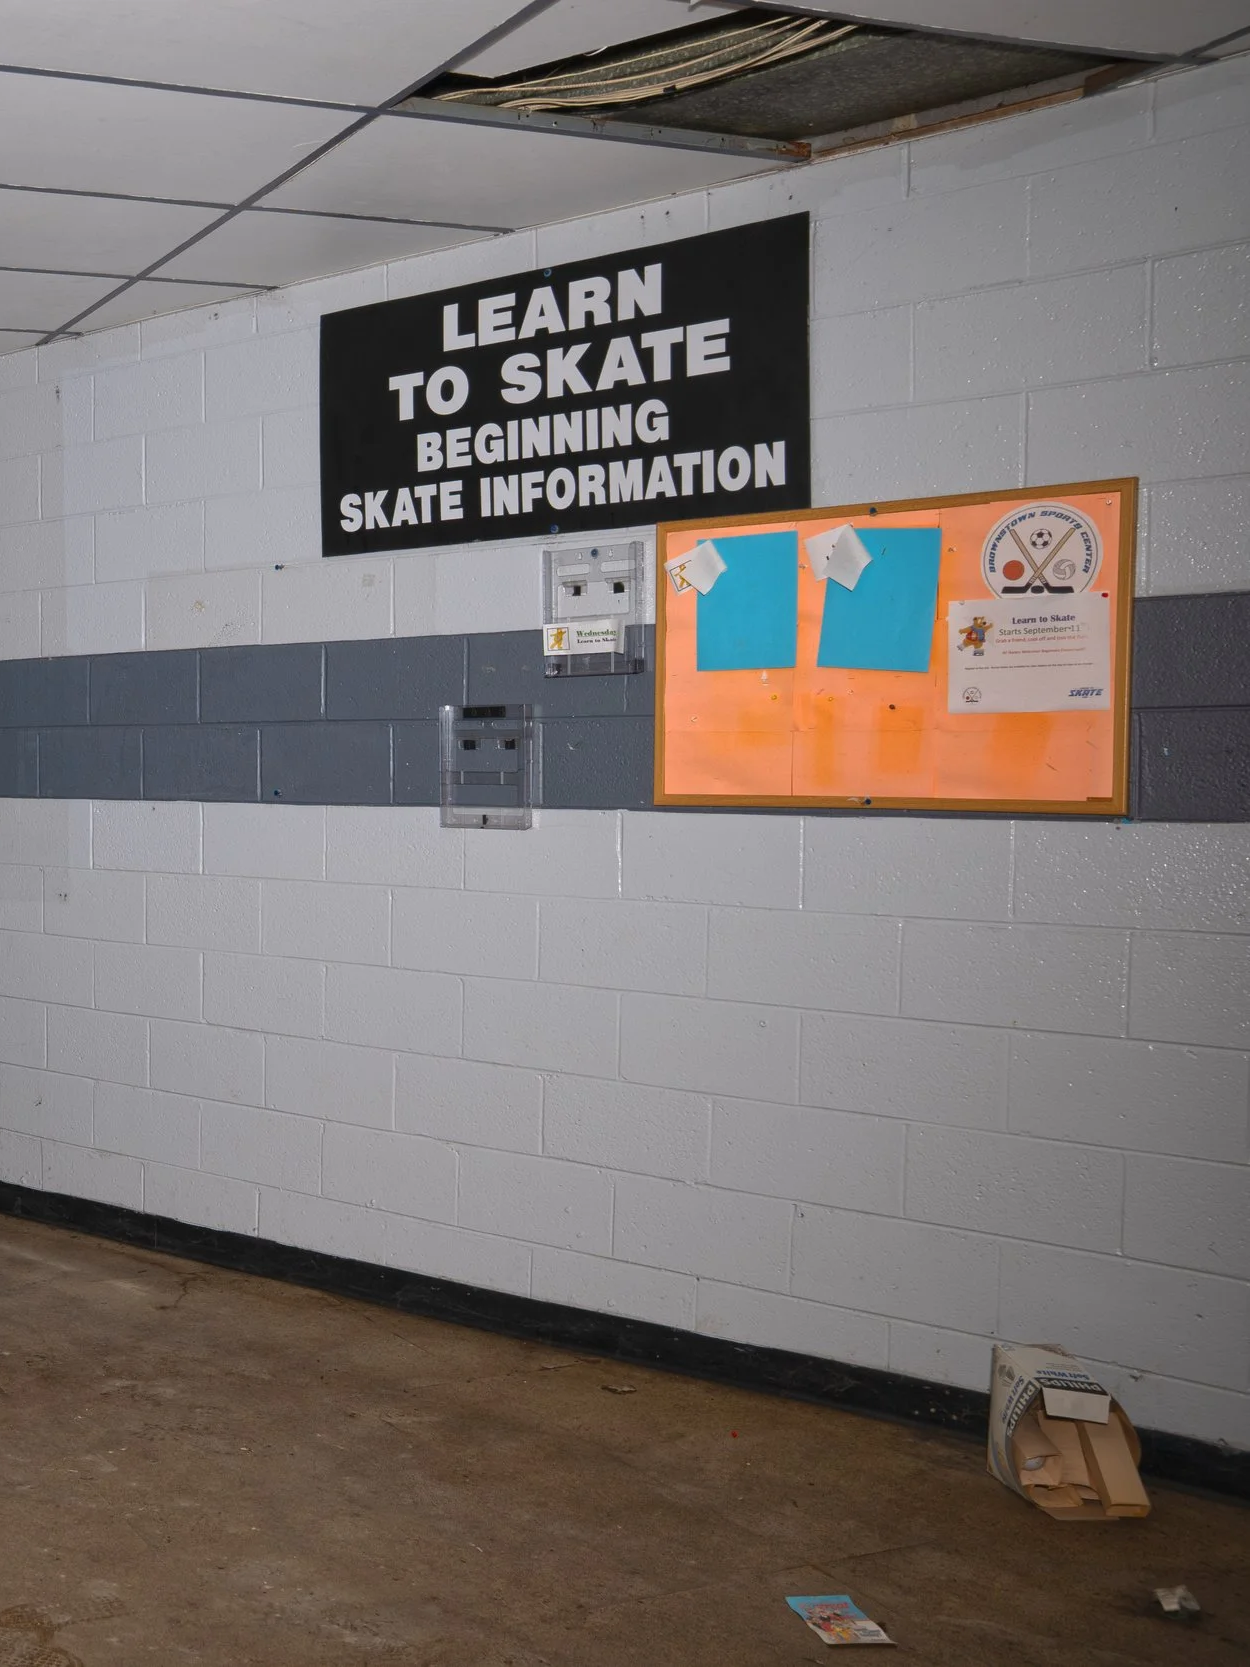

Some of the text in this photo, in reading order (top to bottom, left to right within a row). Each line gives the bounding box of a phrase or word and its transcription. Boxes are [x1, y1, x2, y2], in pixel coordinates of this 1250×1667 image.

[443, 262, 663, 352] LEARN
[389, 317, 731, 421] TO SKATE
[417, 398, 670, 472] BEGINNING
[340, 440, 787, 532] SKATE INFORMATION
[988, 509, 1094, 575] BROWNSTOWN SPORTS CENTER
[999, 628, 1022, 636] Starts
[1023, 624, 1068, 635] September
[1012, 616, 1037, 624] Learn
[1050, 614, 1076, 622] Skate
[1068, 688, 1104, 697] SKATE
[1039, 1378, 1104, 1392] PHILIPS
